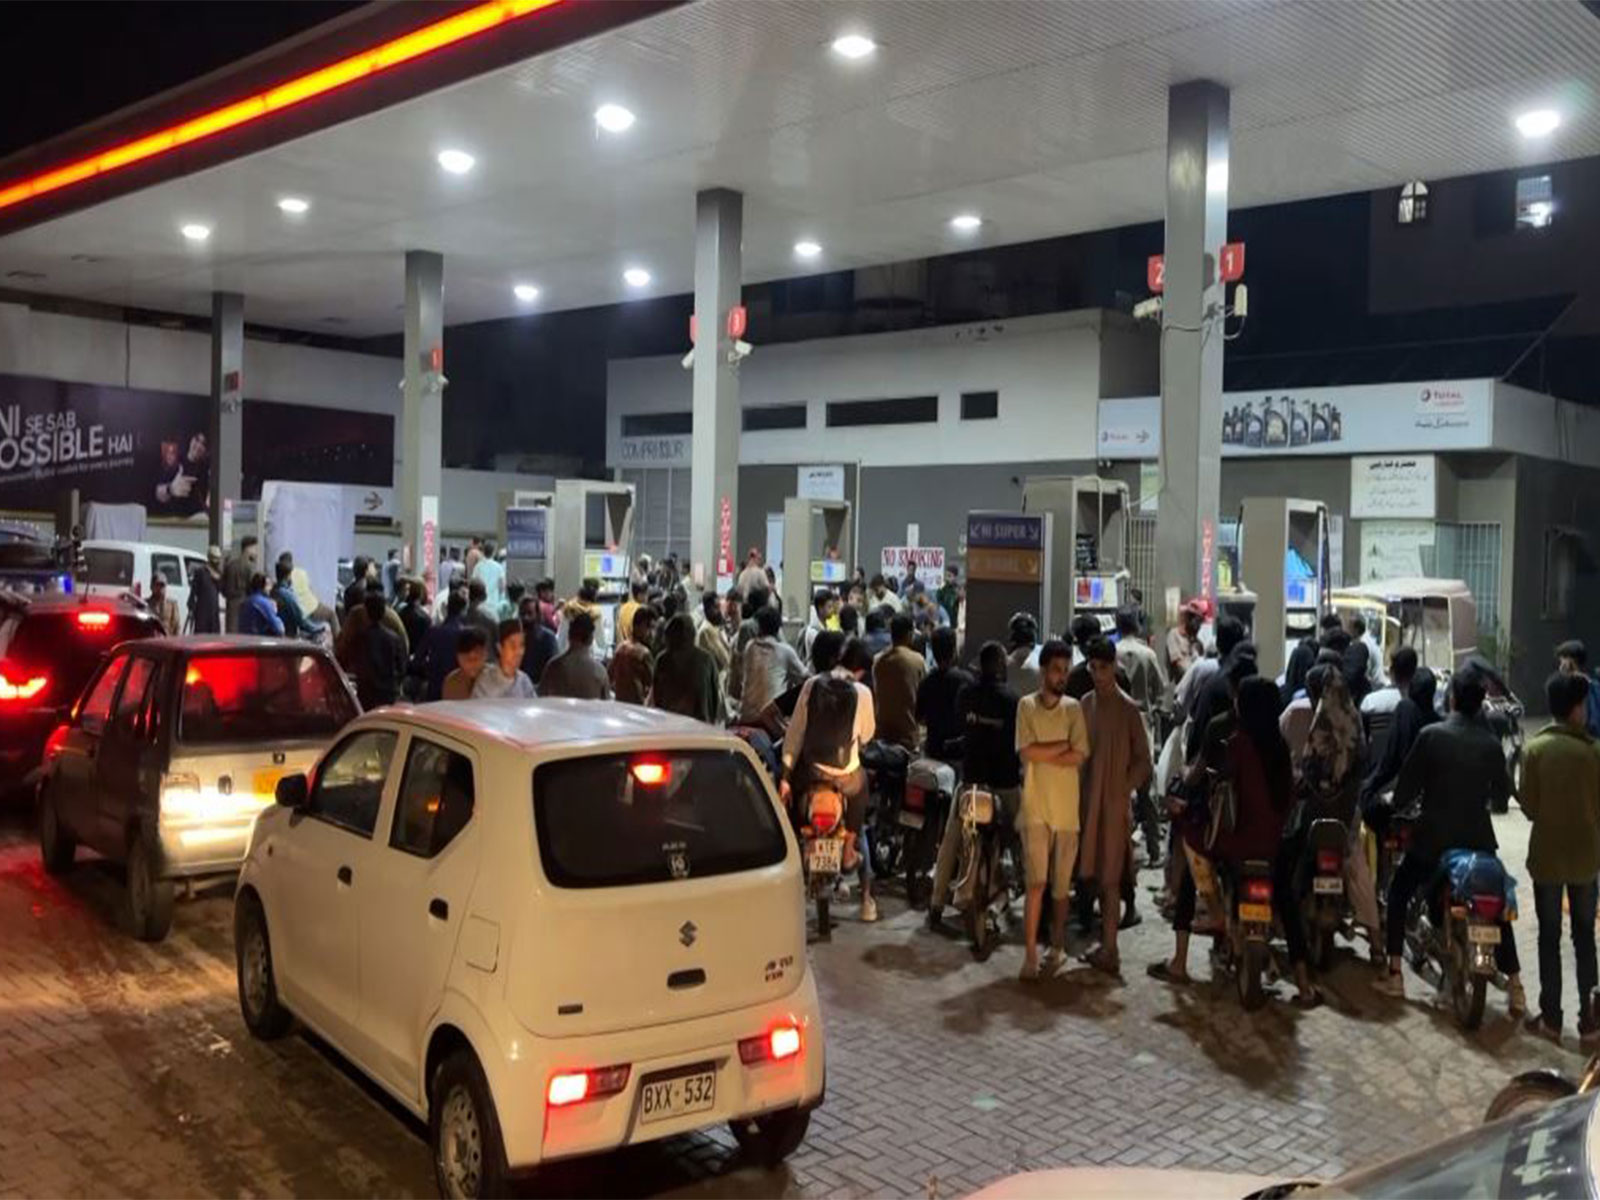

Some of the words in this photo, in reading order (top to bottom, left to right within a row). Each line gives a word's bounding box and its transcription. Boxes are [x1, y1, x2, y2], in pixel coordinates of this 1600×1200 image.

[1226, 251, 1234, 275] 1
[25, 414, 43, 436] SE
[45, 410, 76, 432] SAB
[107, 434, 133, 455] HAI
[883, 548, 896, 568] NO
[899, 548, 943, 568] SMOKING
[644, 1082, 673, 1115] BXX
[684, 1074, 713, 1106] 532
